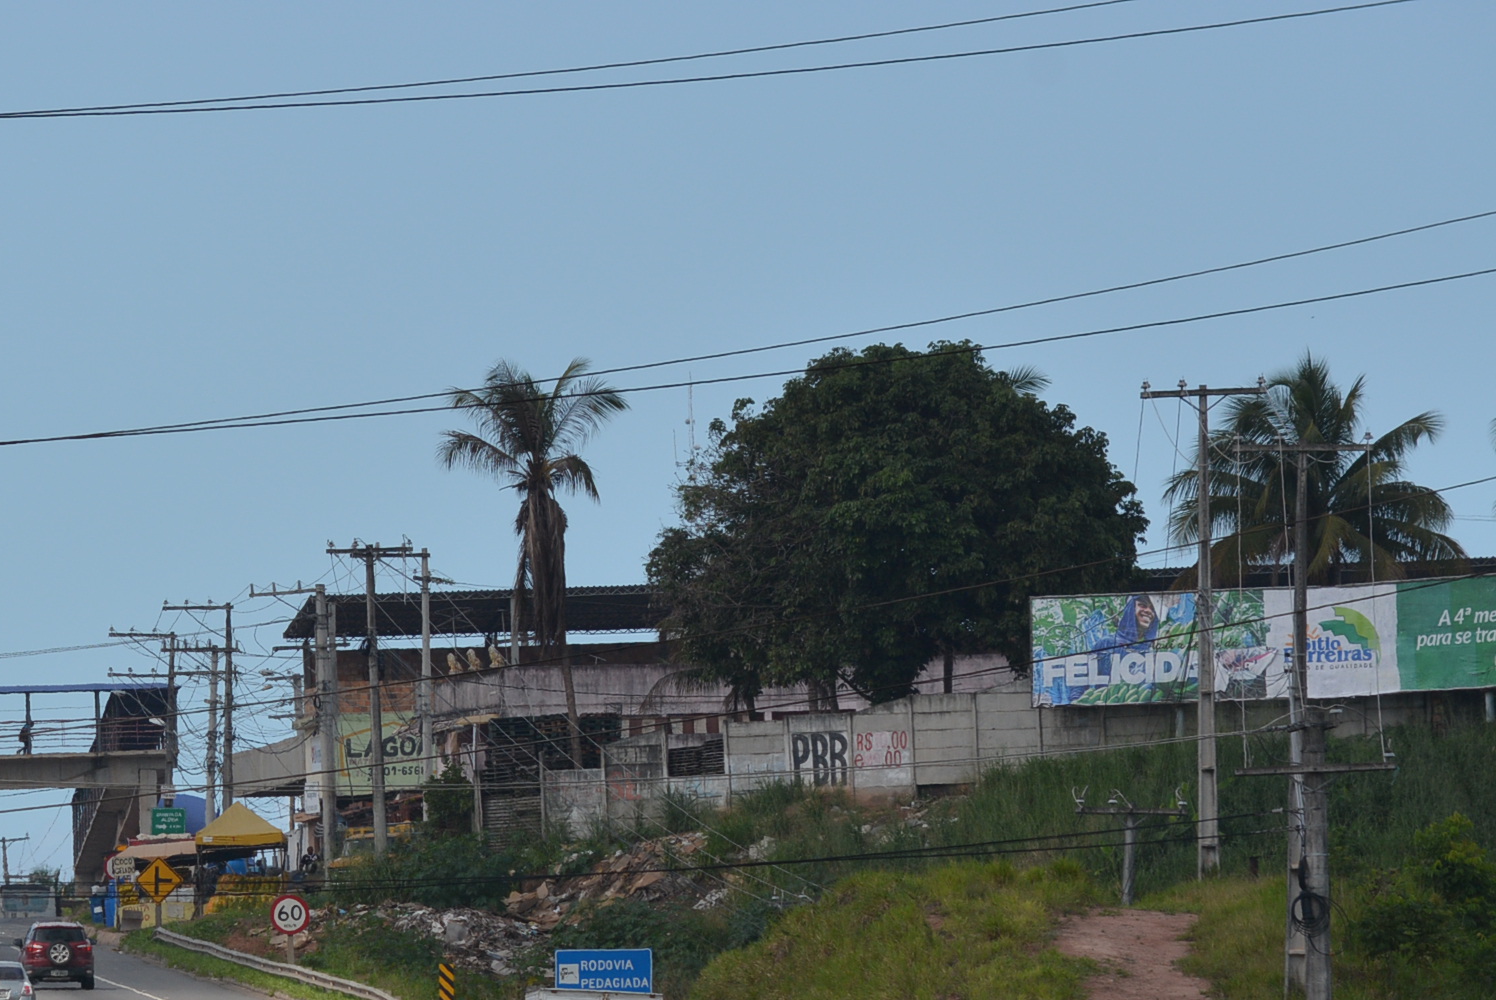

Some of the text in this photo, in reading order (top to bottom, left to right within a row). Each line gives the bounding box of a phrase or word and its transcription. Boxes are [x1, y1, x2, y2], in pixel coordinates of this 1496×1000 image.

[1437, 609, 1451, 627] A
[1416, 633, 1452, 651] para
[1455, 631, 1472, 645] se
[1283, 648, 1373, 663] Brreiras
[277, 904, 303, 922] 60
[580, 959, 634, 971] RODOVIA
[580, 977, 649, 989] PEDAGIADA
